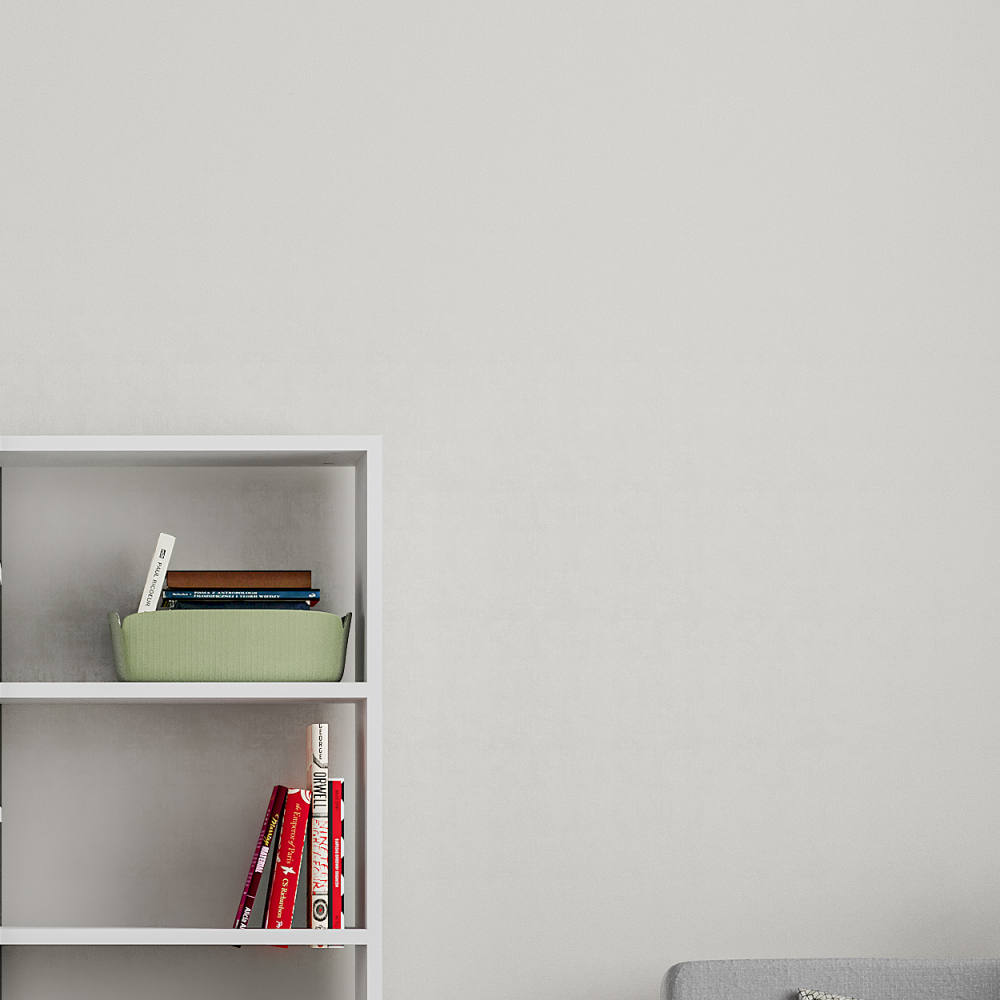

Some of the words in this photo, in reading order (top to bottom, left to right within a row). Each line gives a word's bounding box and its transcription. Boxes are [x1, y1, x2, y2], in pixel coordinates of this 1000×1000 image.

[313, 771, 327, 809] ORWELL
[289, 811, 301, 841] Emperor
[286, 847, 296, 864] Paris
